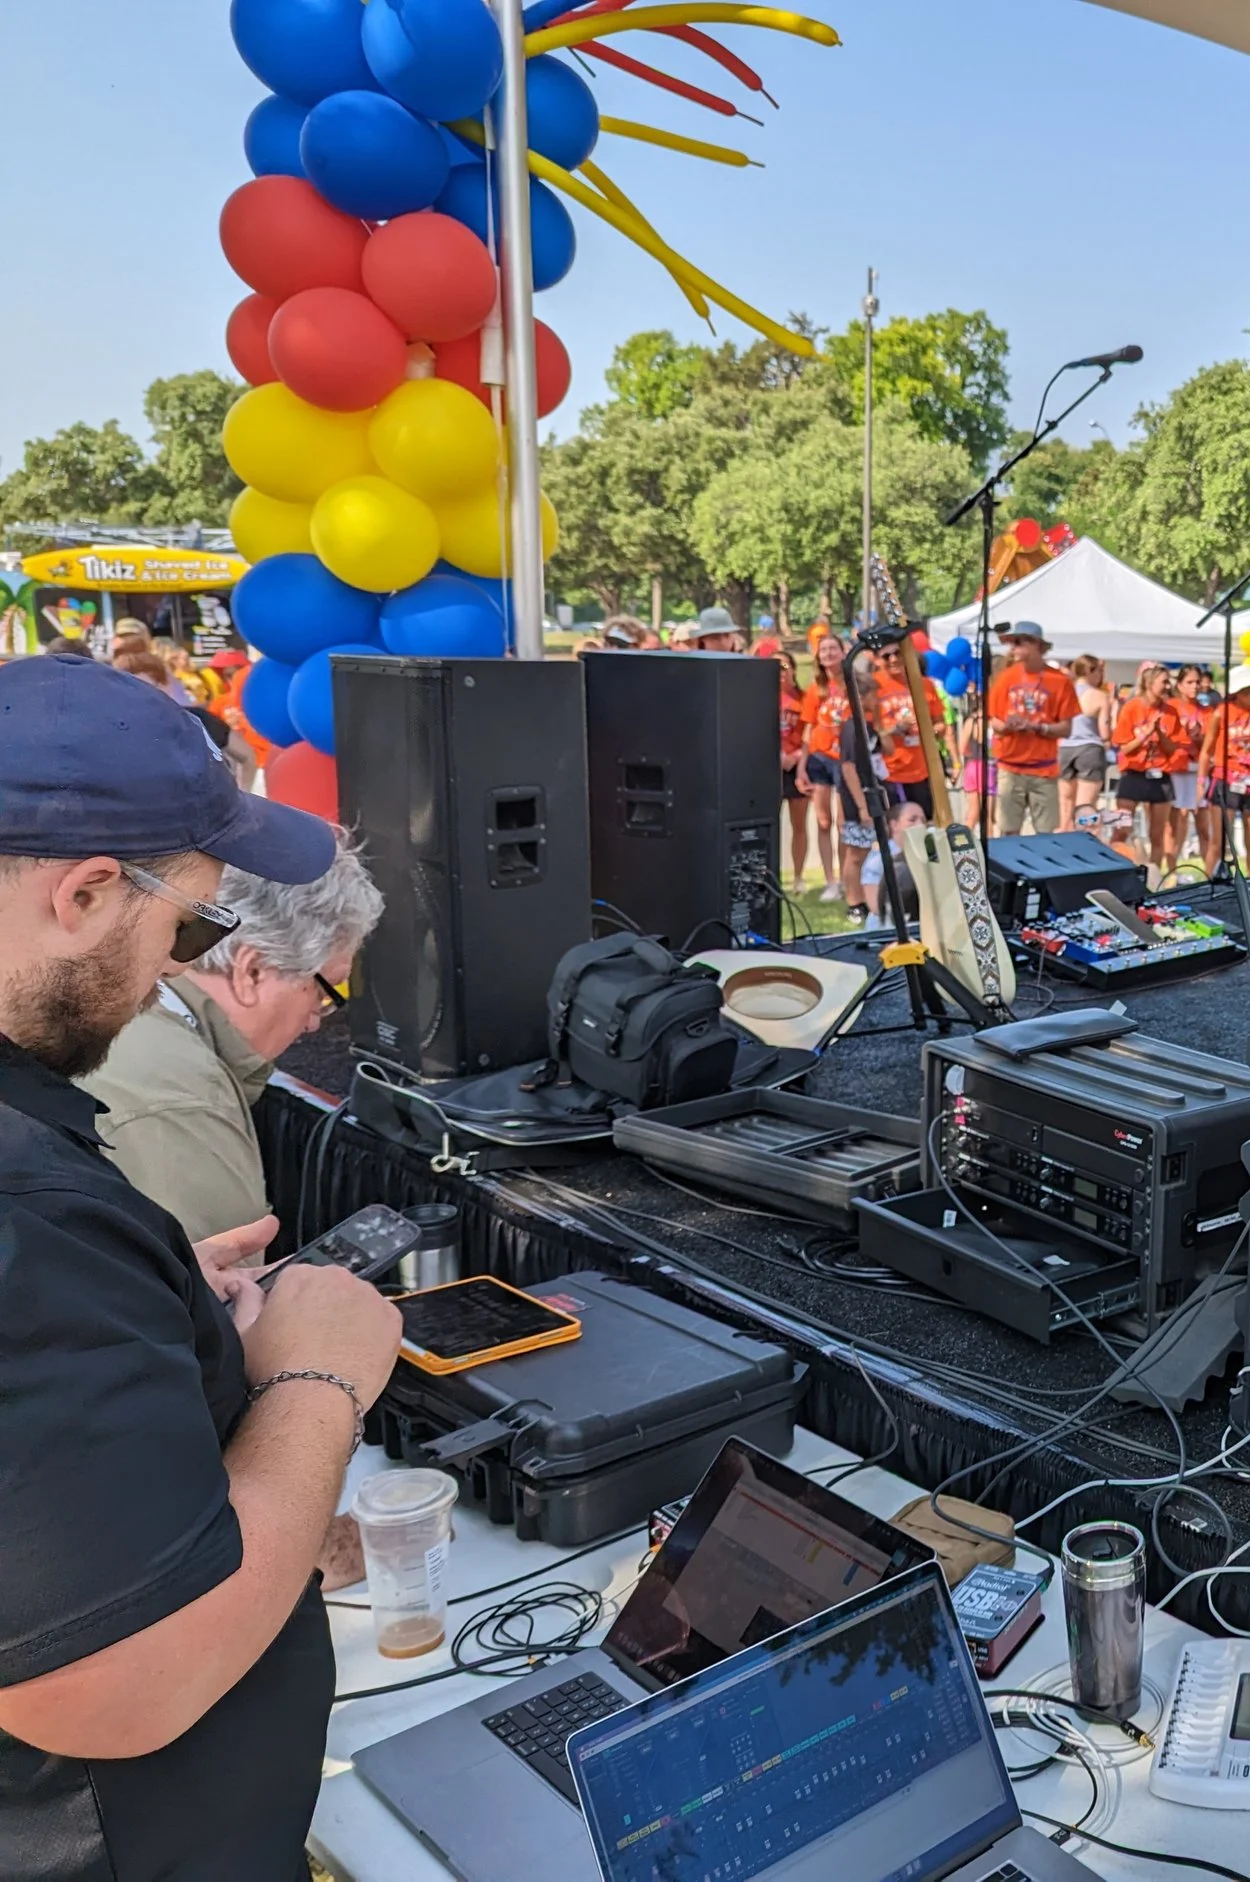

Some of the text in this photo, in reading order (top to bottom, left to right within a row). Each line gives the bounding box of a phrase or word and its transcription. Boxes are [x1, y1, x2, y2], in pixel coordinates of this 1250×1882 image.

[79, 555, 136, 580] Tikiz
[144, 560, 229, 570] Shaved Ice
[155, 571, 178, 581] Ice
[183, 571, 232, 581] Cream
[952, 1586, 999, 1611] USB
